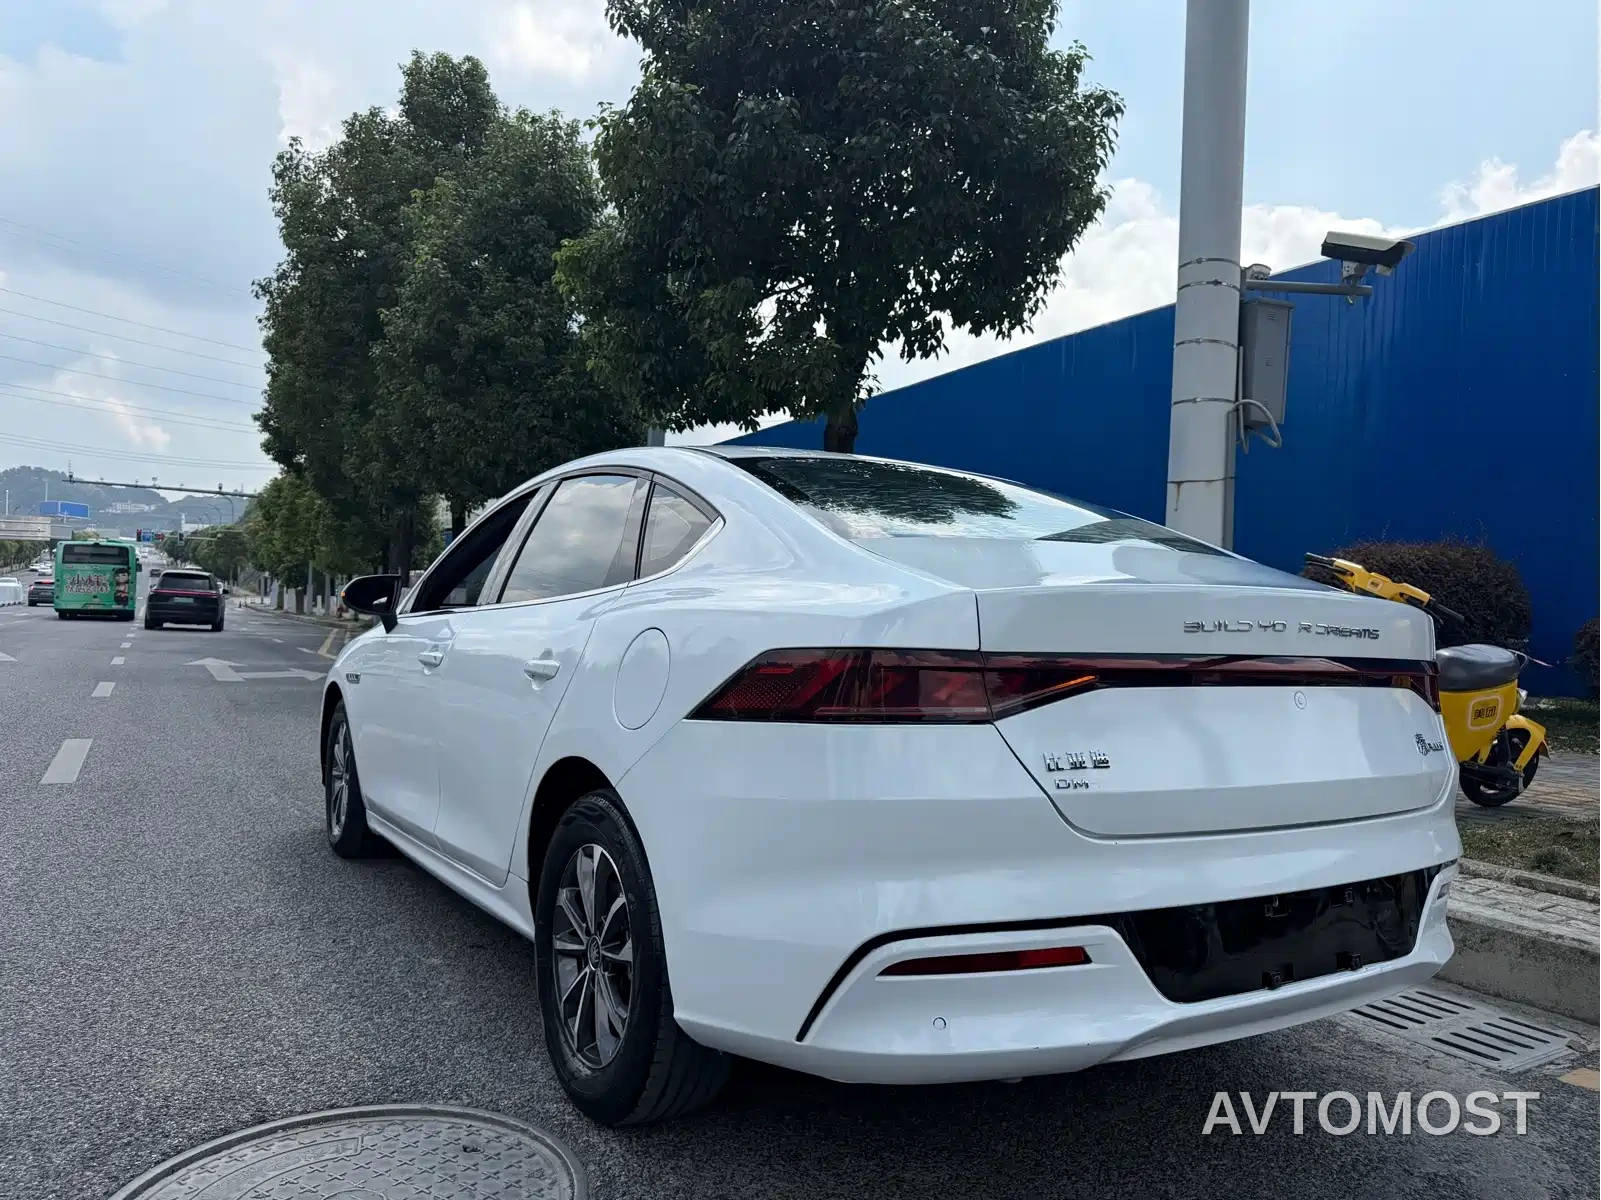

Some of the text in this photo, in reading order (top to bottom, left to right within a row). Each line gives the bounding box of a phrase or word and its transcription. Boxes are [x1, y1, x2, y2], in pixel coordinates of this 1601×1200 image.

[1184, 620, 1253, 633] BUILD
[1315, 623, 1380, 640] DREAMS
[1474, 706, 1496, 720] 美团
[1043, 750, 1110, 771] 比亚迪
[1055, 779, 1089, 789] DM
